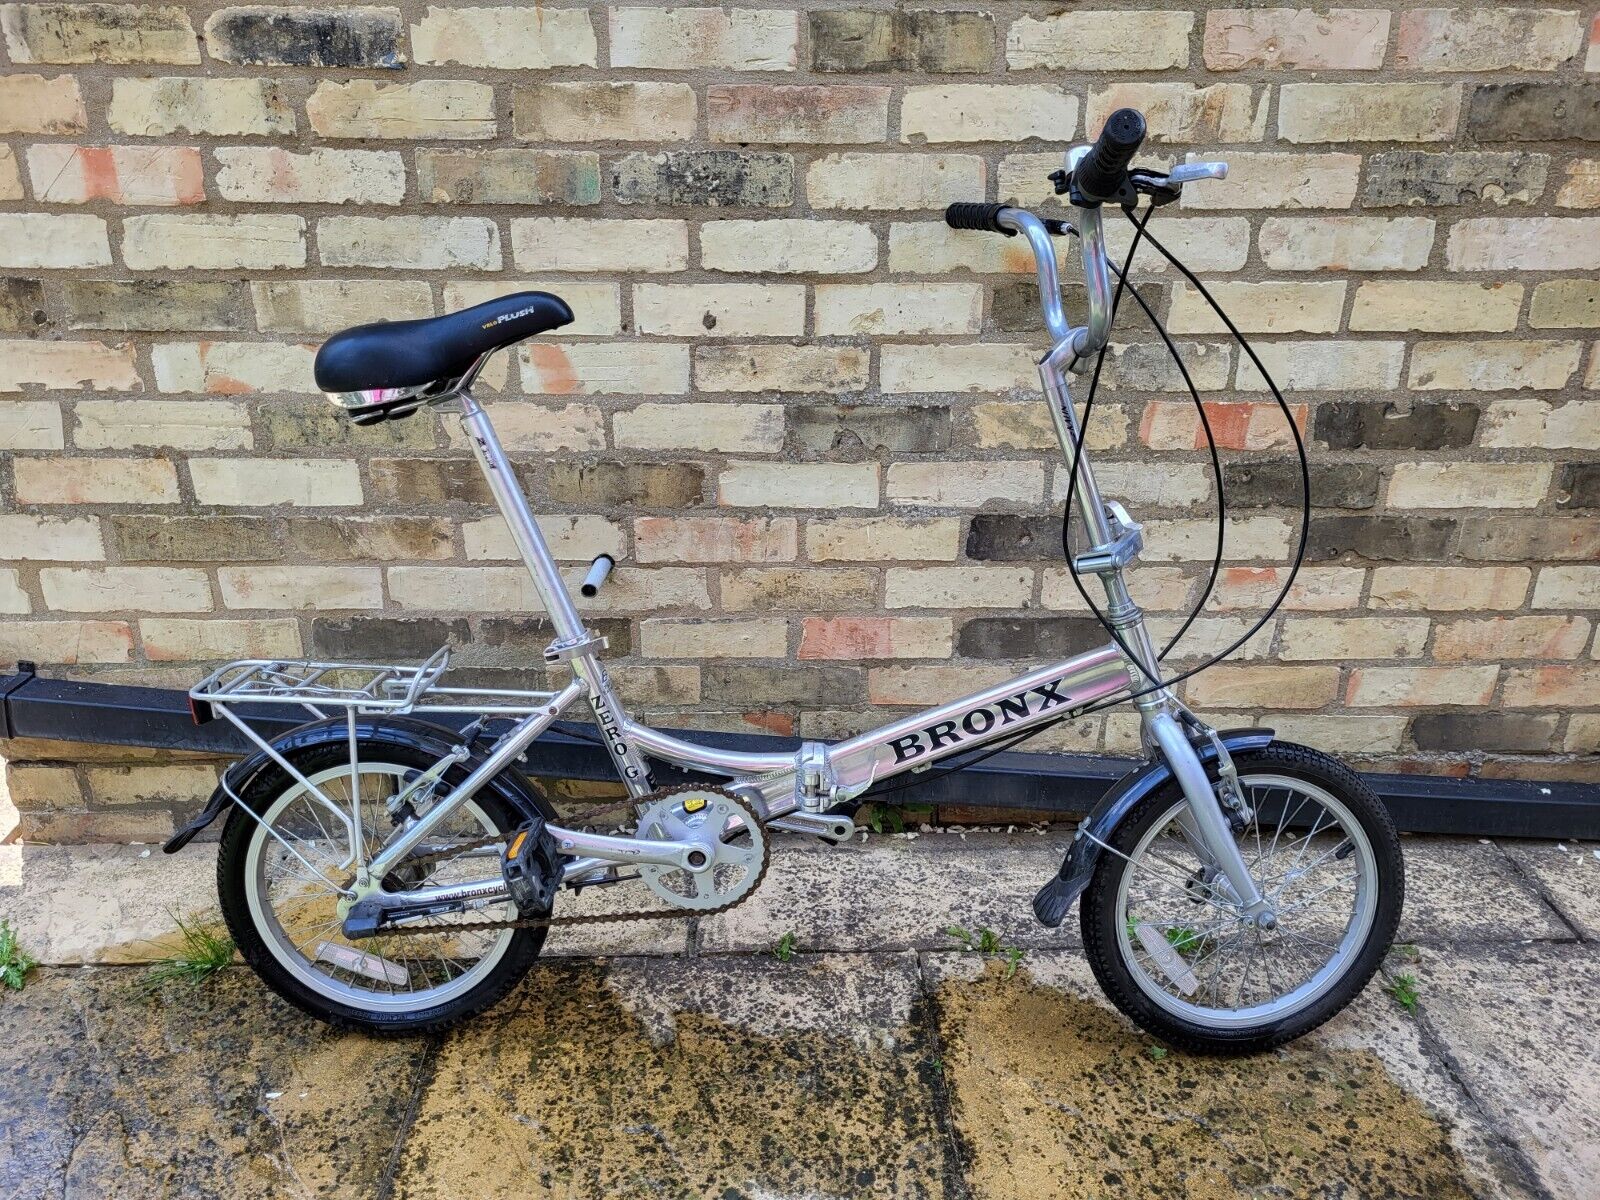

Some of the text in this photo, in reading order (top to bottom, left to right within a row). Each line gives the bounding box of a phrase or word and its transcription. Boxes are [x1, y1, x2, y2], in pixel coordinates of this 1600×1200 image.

[497, 305, 535, 324] PLUSH
[591, 695, 627, 756] ZERO
[624, 765, 639, 779] G
[886, 677, 1072, 765] BRONX
[434, 882, 508, 902] www.bronxcycl
